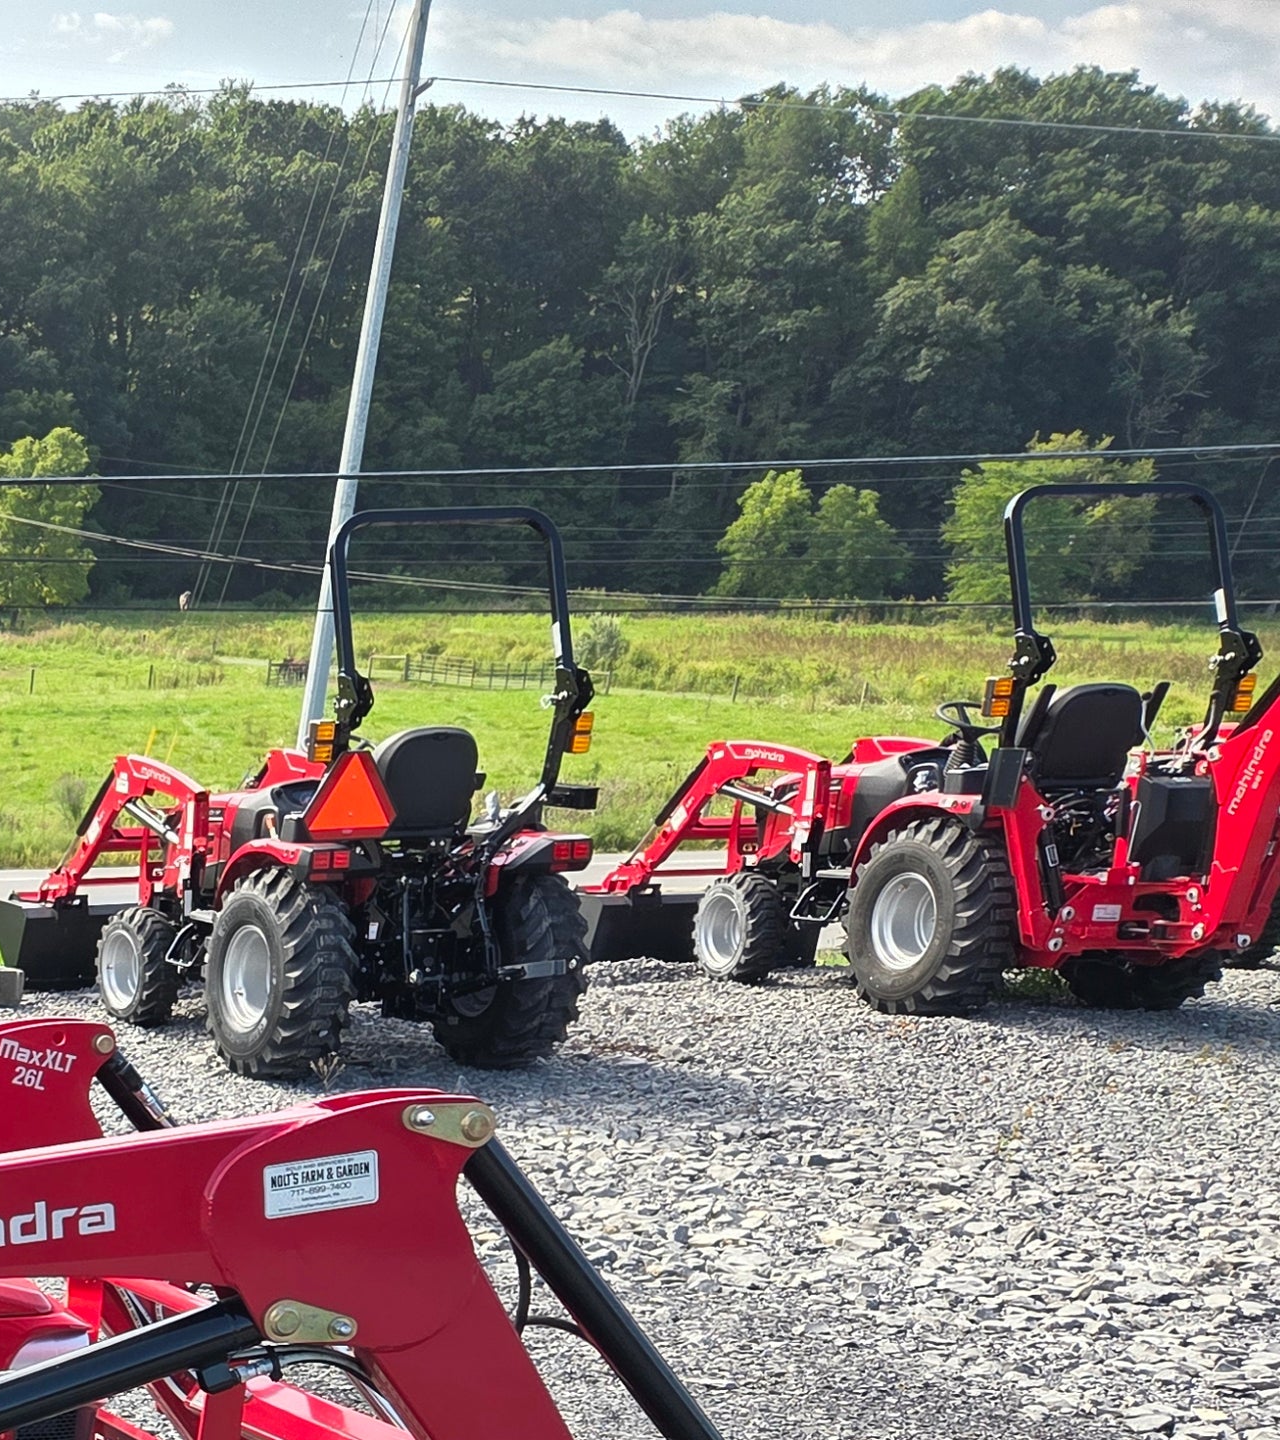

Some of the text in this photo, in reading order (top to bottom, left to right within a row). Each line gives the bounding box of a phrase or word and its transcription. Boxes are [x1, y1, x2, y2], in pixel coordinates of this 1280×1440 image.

[11, 1066, 45, 1091] 26L
[270, 1161, 370, 1188] NOLT'S FARM & GARDEN
[290, 1181, 352, 1197] 717-899-7400
